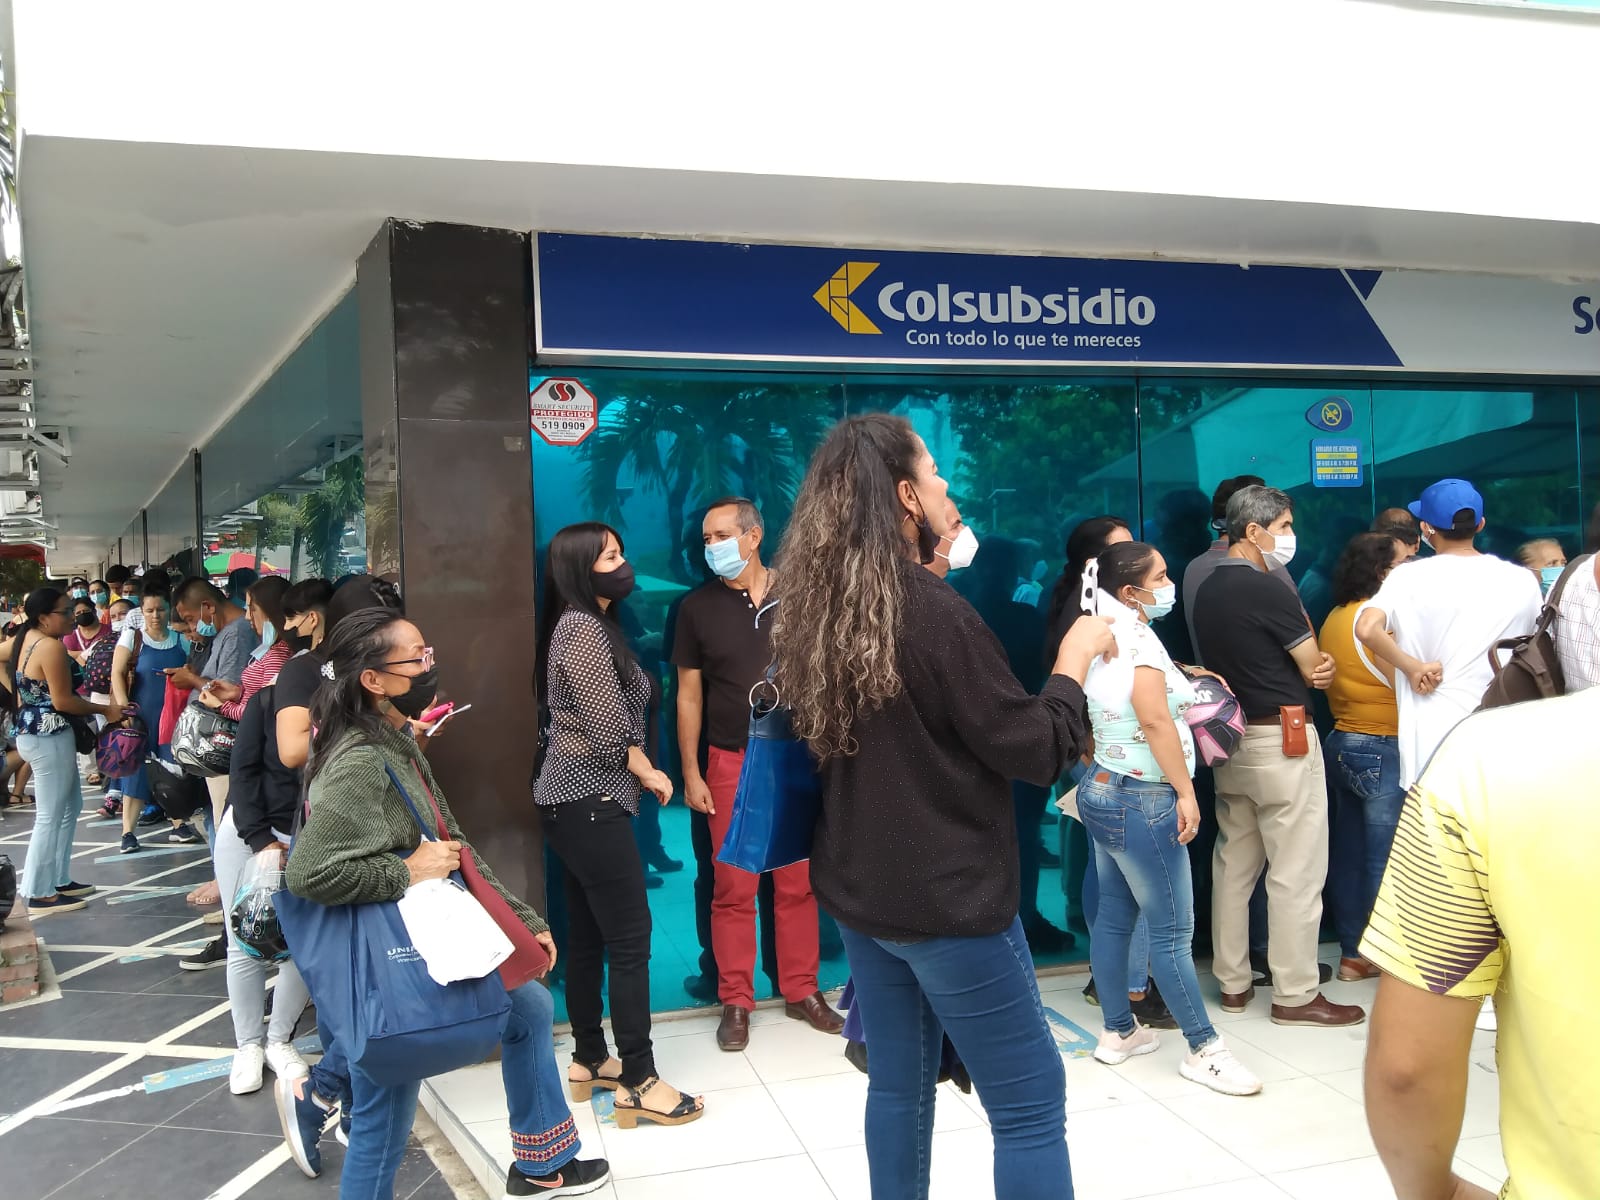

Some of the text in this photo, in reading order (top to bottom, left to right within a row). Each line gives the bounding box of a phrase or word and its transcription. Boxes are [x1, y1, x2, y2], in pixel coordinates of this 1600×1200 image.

[878, 281, 1156, 326] Colsubsidio
[1572, 296, 1600, 335] S
[906, 329, 1142, 350] Con todo lo que te mereces
[533, 409, 592, 418] PROTEGIDO
[541, 420, 559, 430] 519
[562, 421, 585, 431] 0909
